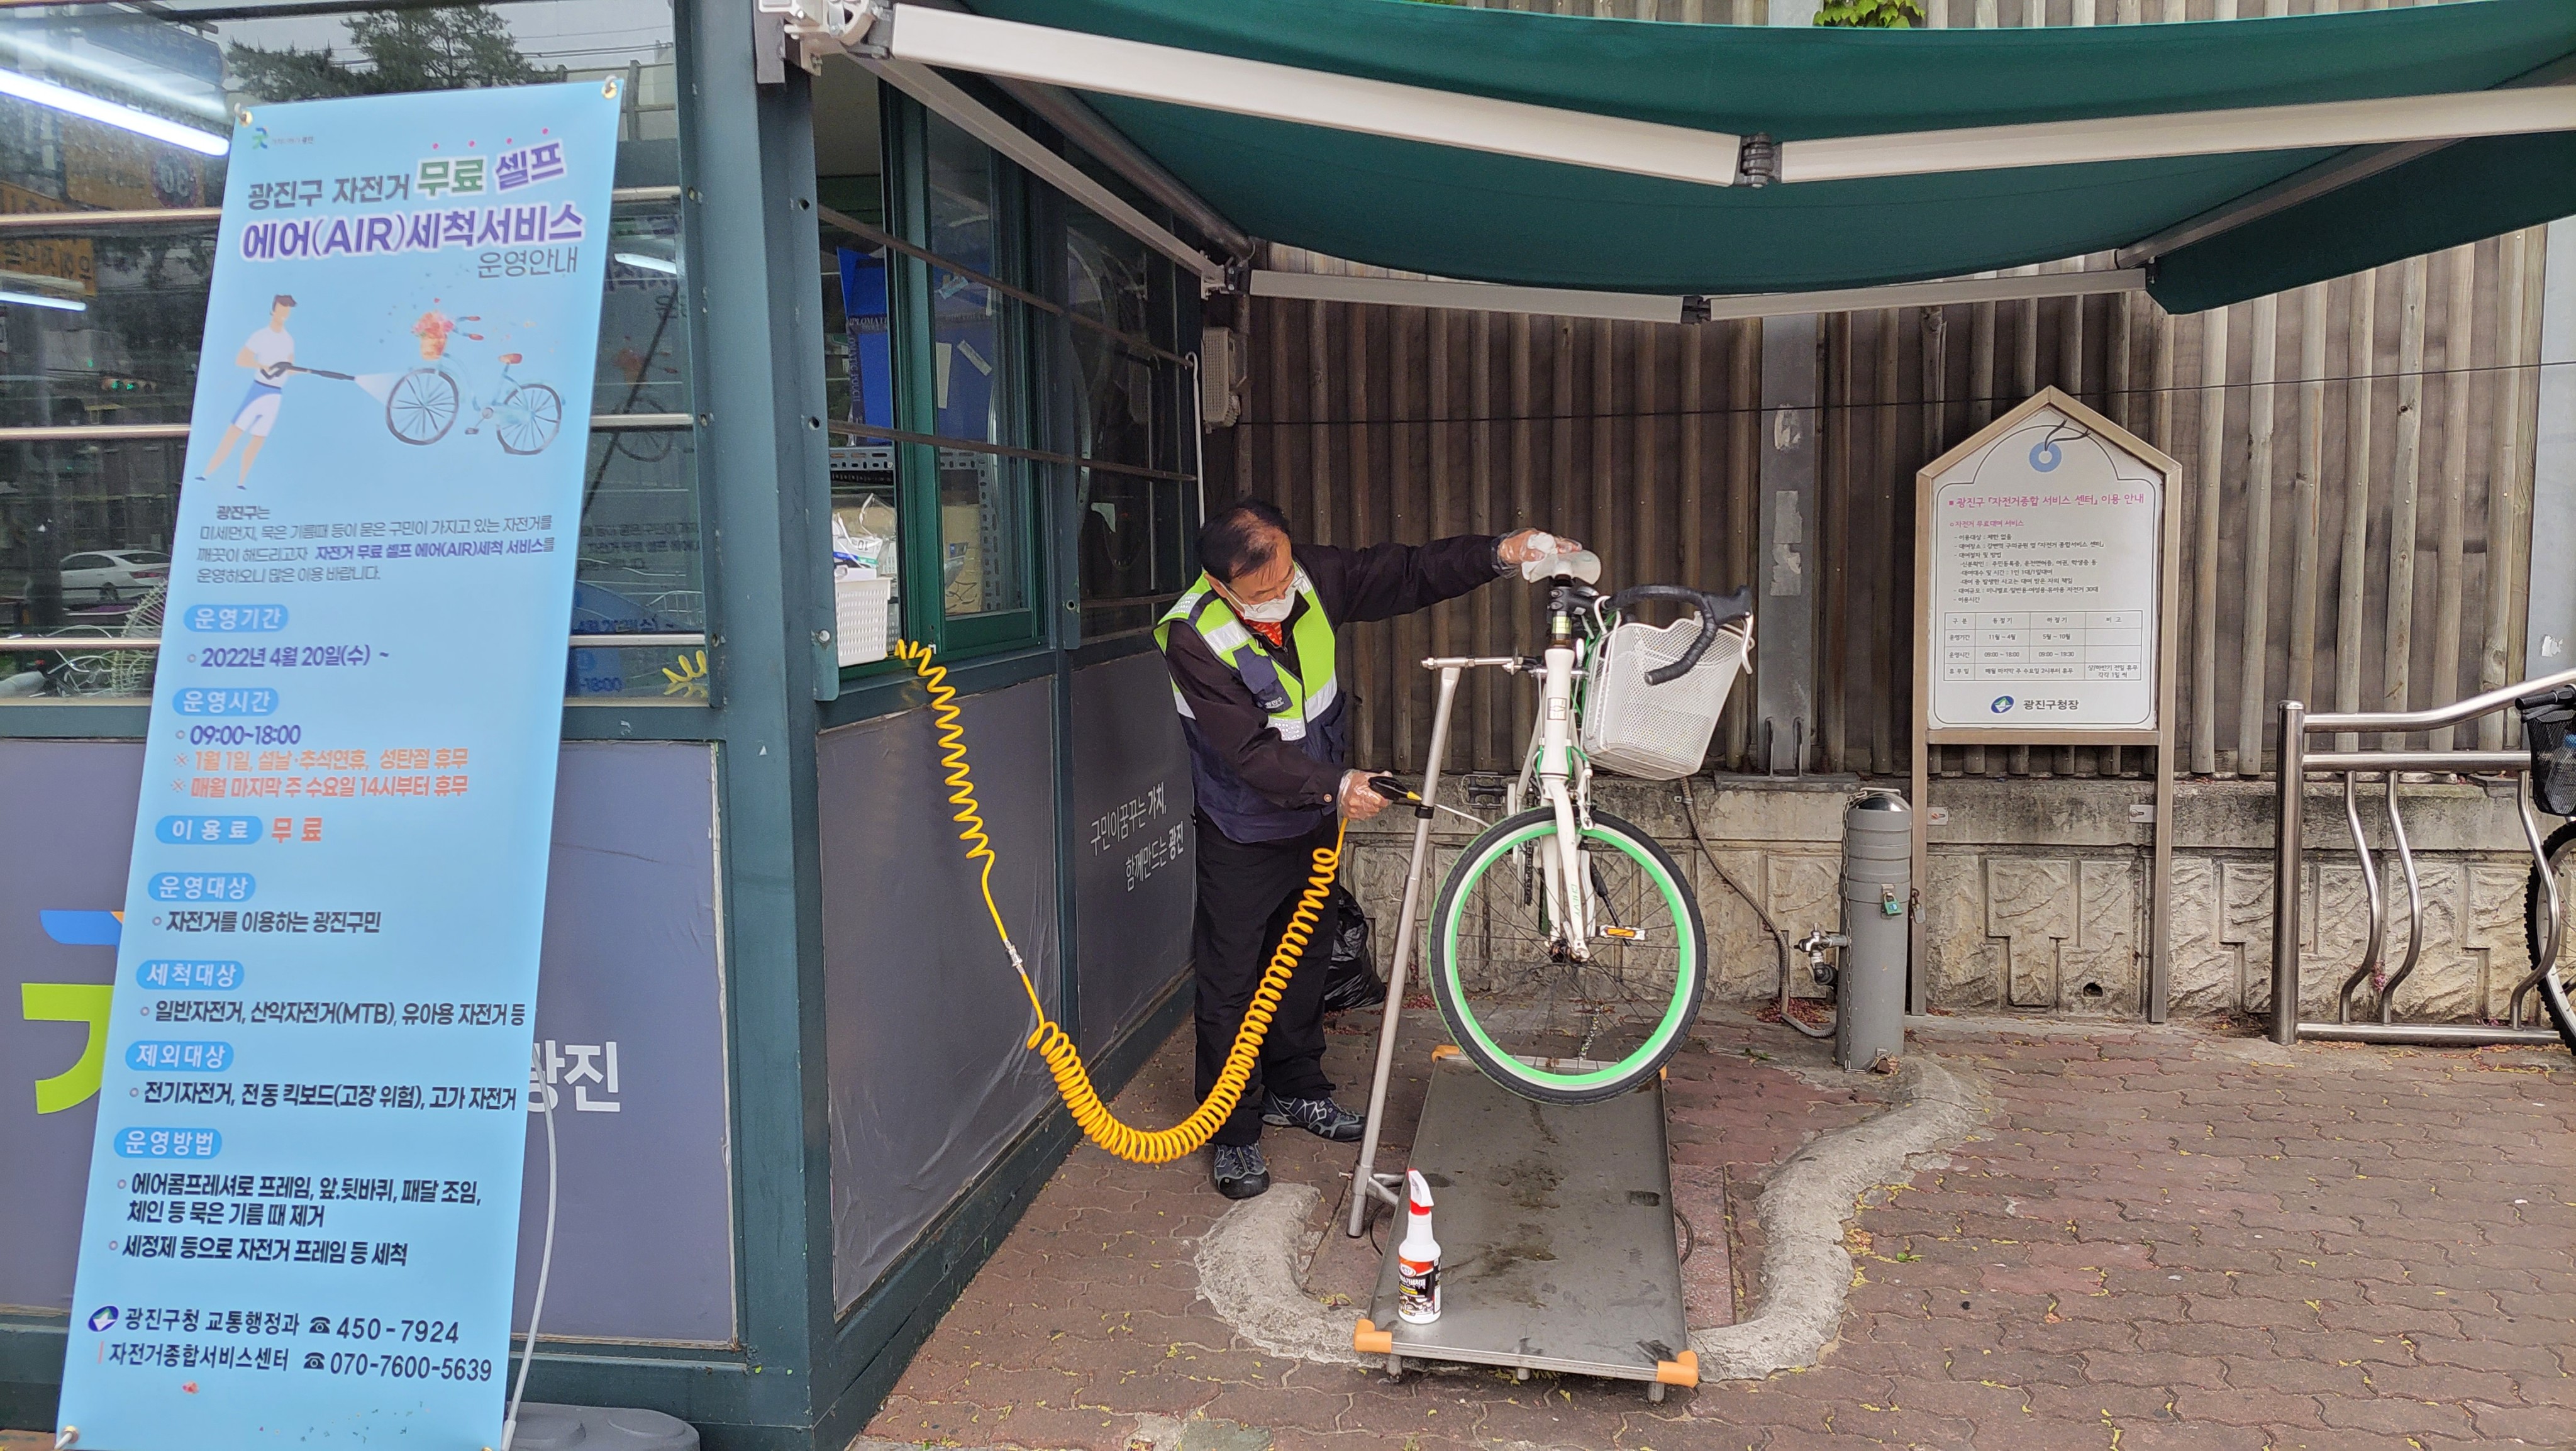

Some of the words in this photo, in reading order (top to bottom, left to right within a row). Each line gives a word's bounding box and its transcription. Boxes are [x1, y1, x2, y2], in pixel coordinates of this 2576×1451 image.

[248, 180, 323, 210] 광진구
[332, 174, 410, 204] 자전거
[418, 159, 484, 196] 무료
[496, 143, 564, 191] 셀프
[243, 204, 583, 259] 에어(AIR)세척서비스
[477, 246, 578, 279] 운영안내
[216, 505, 270, 520] 광진구는
[1957, 497, 1985, 508] 광진구
[2043, 495, 2070, 506] 서비스
[2101, 494, 2121, 504] 이용
[2124, 493, 2145, 505] 안내
[261, 525, 287, 540] 묵은
[291, 524, 328, 539] 기름때
[331, 523, 357, 538] 등이
[360, 522, 386, 537] 묻은
[389, 520, 428, 536] 구민이
[431, 519, 470, 535] 가지고
[474, 518, 500, 533] 있는
[502, 514, 552, 533] 자전거를
[197, 547, 240, 562] 깨끗이
[242, 547, 308, 562] 해드리고자
[315, 545, 354, 560] 자전거
[357, 544, 383, 559] 무료
[386, 543, 412, 559] 셀프
[415, 540, 503, 558] 에어(AIR)세척
[506, 536, 555, 554] 서비스를
[196, 567, 267, 584] 운영하오니
[269, 567, 295, 583] 많은
[297, 567, 323, 582] 이용
[325, 565, 381, 581] 바랍니다.
[194, 608, 282, 630] 운영기간
[200, 647, 266, 667] 2022년
[269, 646, 299, 667] 4월
[301, 644, 371, 667] 20일(수)
[183, 690, 271, 714] 운영시간
[2023, 699, 2079, 710] 광진구청장
[189, 724, 301, 746] 09:00~18:00
[194, 750, 221, 772] 1월
[379, 748, 430, 770] 성탄절
[434, 747, 469, 770] 휴무
[191, 776, 227, 799] 매월
[230, 776, 282, 799] 마지막
[284, 776, 302, 798] 주
[305, 776, 356, 798] 수요일
[360, 775, 430, 798] 14시부터
[433, 775, 469, 798] 휴무
[1169, 821, 1184, 860] 광진
[159, 875, 248, 899] 운영대상
[166, 911, 238, 933] 자전거를
[242, 911, 309, 933] 이용하는
[313, 911, 381, 934] 광진구민
[146, 962, 236, 988] 세척대상
[155, 1000, 247, 1025] 일반자전거,
[250, 1001, 397, 1026] 산악자전거(MTB),
[402, 1002, 454, 1026] 유아용
[457, 1003, 507, 1026] 자전거
[511, 1003, 525, 1026] 등
[136, 1044, 226, 1069] 제외대상
[144, 1081, 236, 1106] 전기자전거,
[242, 1083, 280, 1108] 전동
[283, 1084, 377, 1108] 킥보드(고장
[429, 1086, 465, 1110] 고가
[468, 1086, 517, 1111] 자전거
[125, 1130, 213, 1156] 운영방법
[131, 1172, 255, 1198] 에어콤프레셔로
[258, 1176, 314, 1201] 프레임,
[401, 1179, 439, 1203] 패달
[441, 1180, 481, 1206] 조임,
[127, 1199, 164, 1223] 체인
[168, 1201, 186, 1224] 등
[189, 1201, 225, 1225] 묵은
[228, 1203, 264, 1226] 기름
[267, 1203, 287, 1226] 때
[289, 1204, 325, 1228] 제거
[122, 1235, 177, 1259] 세정제
[180, 1236, 233, 1260] 등으로
[236, 1238, 291, 1262] 자전거
[294, 1240, 347, 1264] 프레임
[350, 1241, 369, 1265] 등
[371, 1242, 408, 1267] 세척
[125, 1307, 200, 1333] 광진구청
[205, 1309, 300, 1337] 교통행정과
[336, 1317, 459, 1345] 450-7924
[108, 1341, 289, 1371] 자전거종합서비스센터
[330, 1352, 492, 1382] 070-7600-5639
